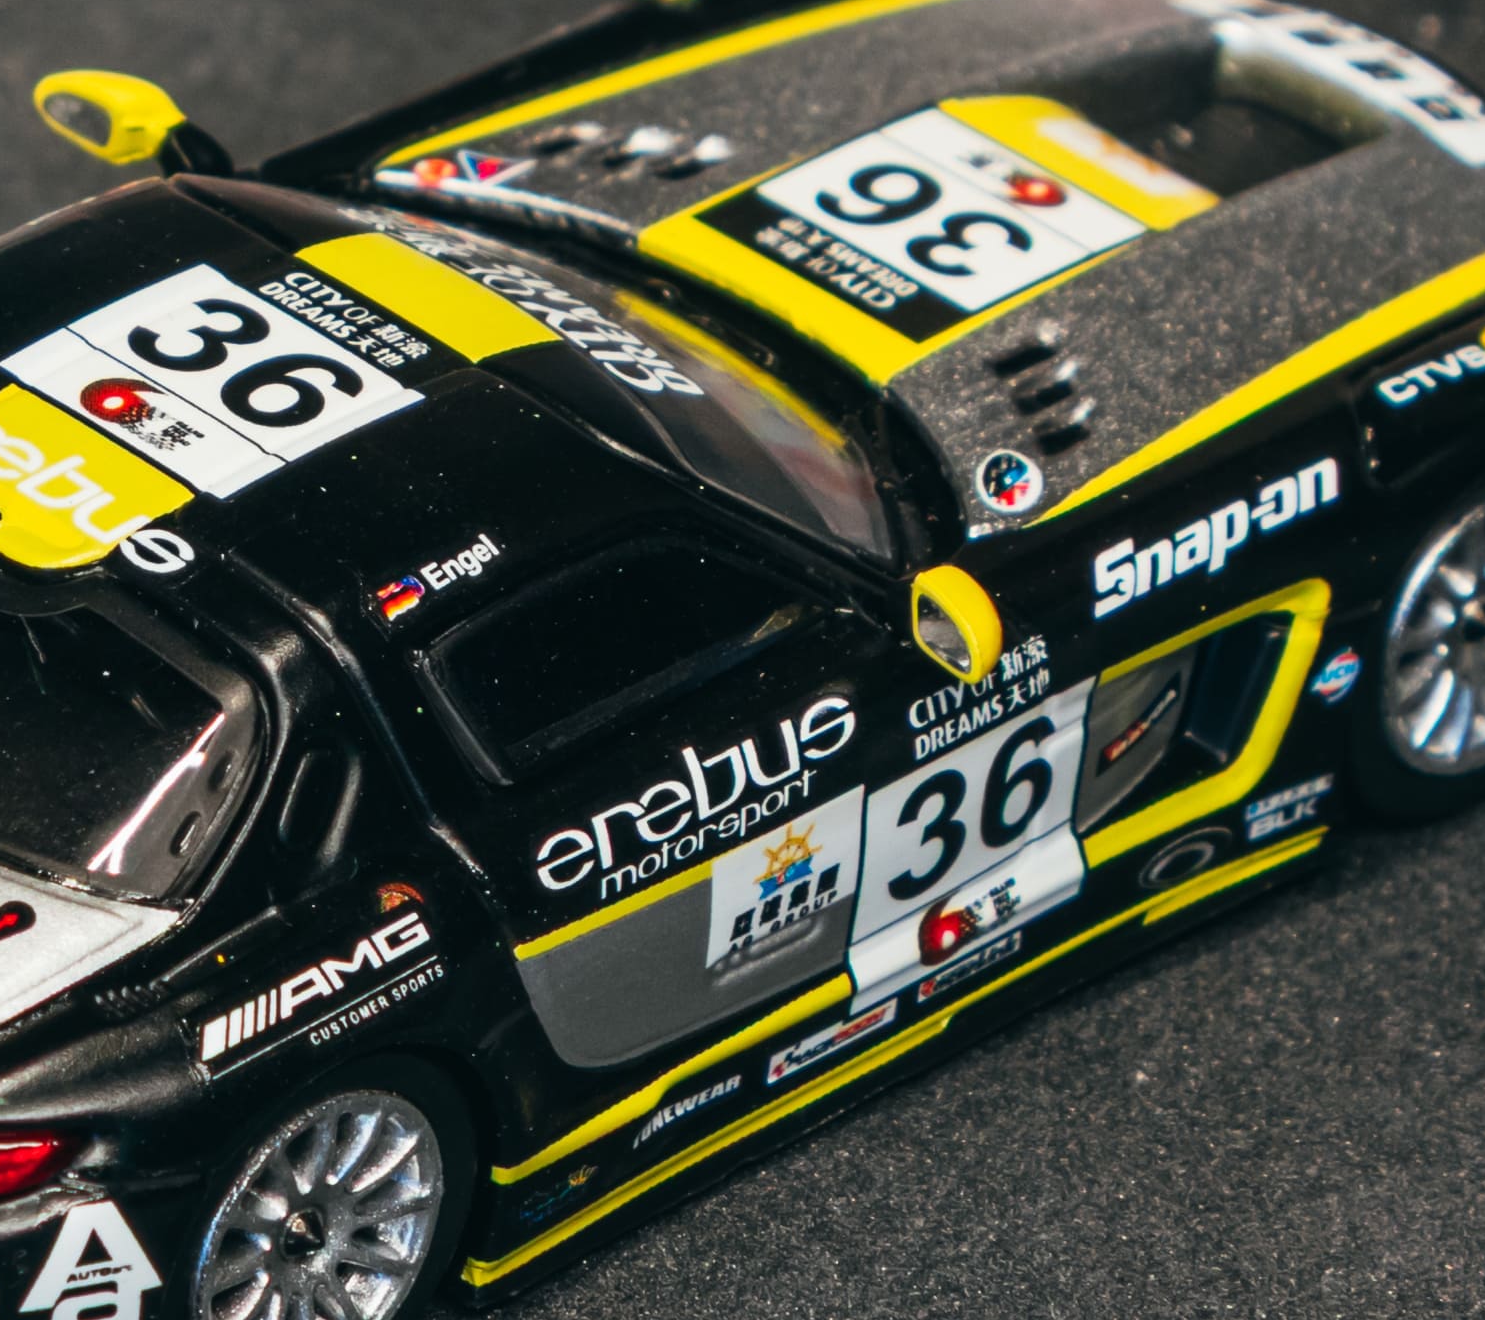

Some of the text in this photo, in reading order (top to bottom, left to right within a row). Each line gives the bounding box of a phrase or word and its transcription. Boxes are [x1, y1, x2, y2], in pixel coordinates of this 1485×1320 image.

[815, 163, 1033, 278] 36
[258, 281, 358, 339] DREAMS
[284, 272, 354, 307] CITY
[343, 306, 384, 326] OF
[127, 298, 364, 428] 36
[420, 533, 500, 592] Engel
[1094, 457, 1339, 620] Snap-on
[908, 679, 965, 729] CITY
[914, 693, 1004, 761] DREAMS
[536, 697, 856, 892] erebus
[600, 768, 817, 901] motorsport
[887, 715, 1056, 902] 36
[280, 911, 431, 1020] AMG
[309, 963, 445, 1046] CUSTOMER SPORTS
[632, 1074, 742, 1150] TUNEWEAR
